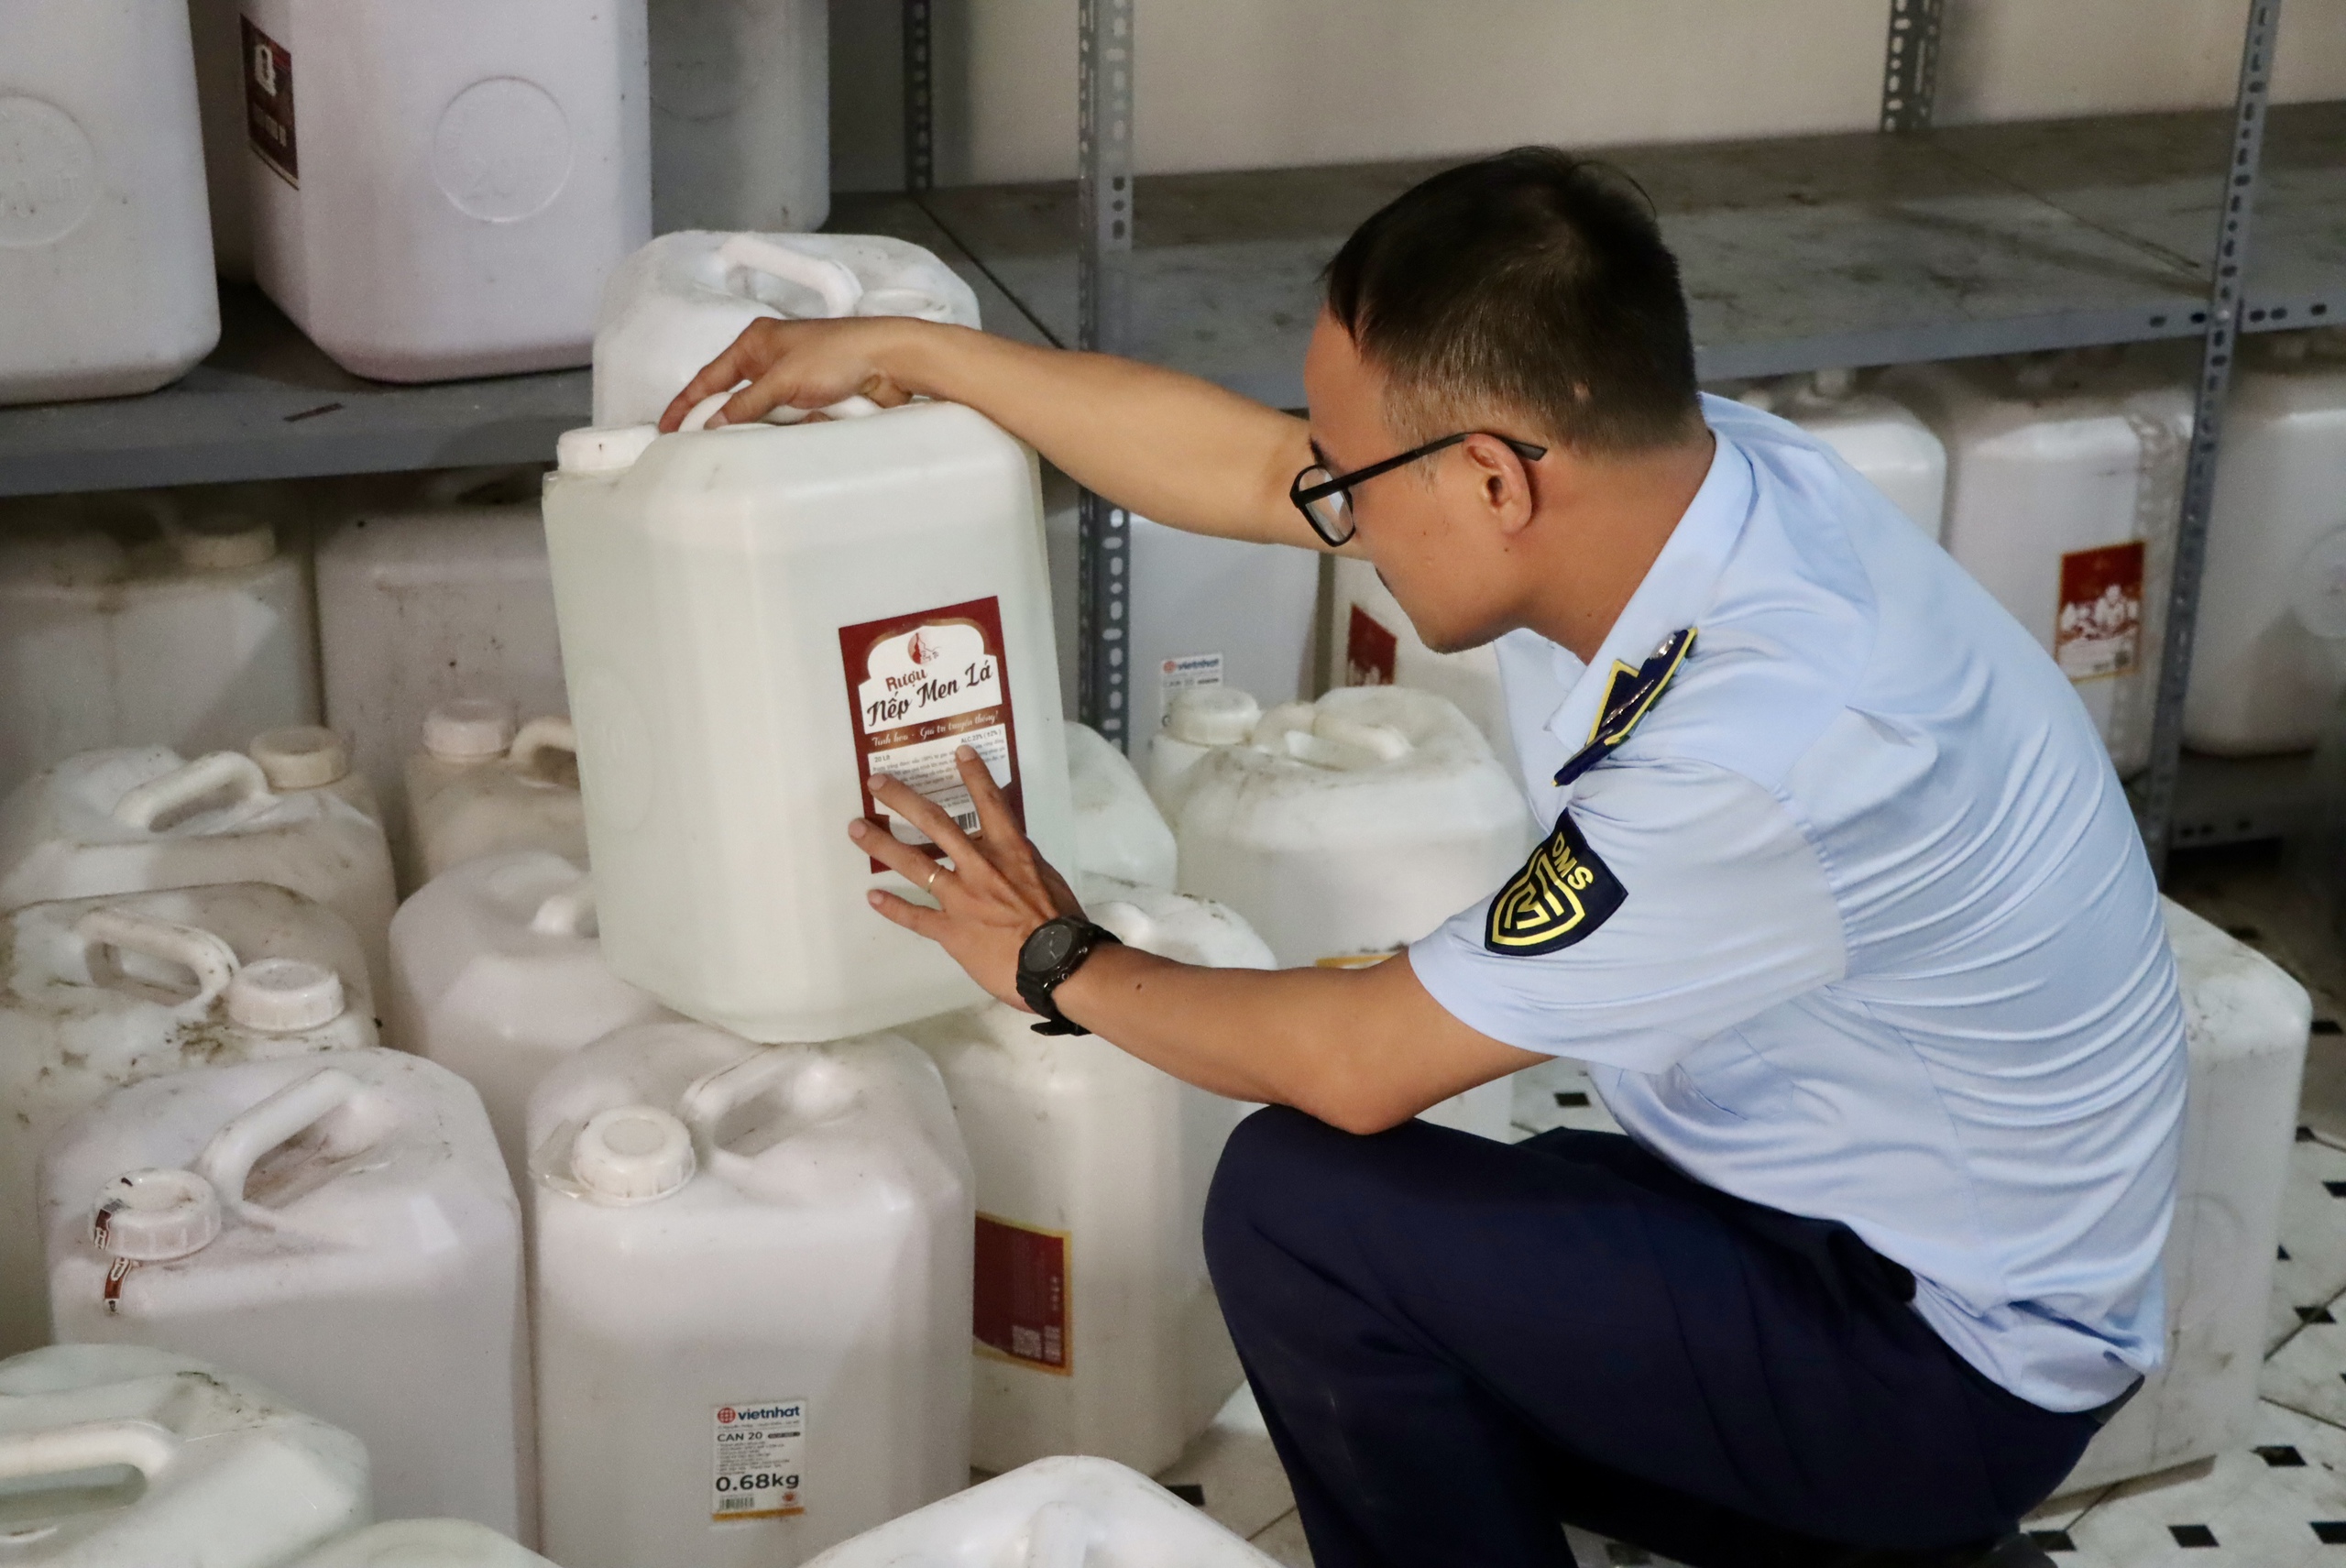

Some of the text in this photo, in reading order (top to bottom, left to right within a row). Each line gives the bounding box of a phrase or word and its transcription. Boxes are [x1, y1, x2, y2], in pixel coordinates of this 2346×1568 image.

[885, 669, 927, 692] Rượu
[867, 660, 993, 727] Nếp Men Lá
[738, 1406, 800, 1420] vietnhat
[718, 1432, 744, 1442] CAN
[748, 1431, 762, 1441] 20
[716, 1473, 799, 1492] 0.68kg
